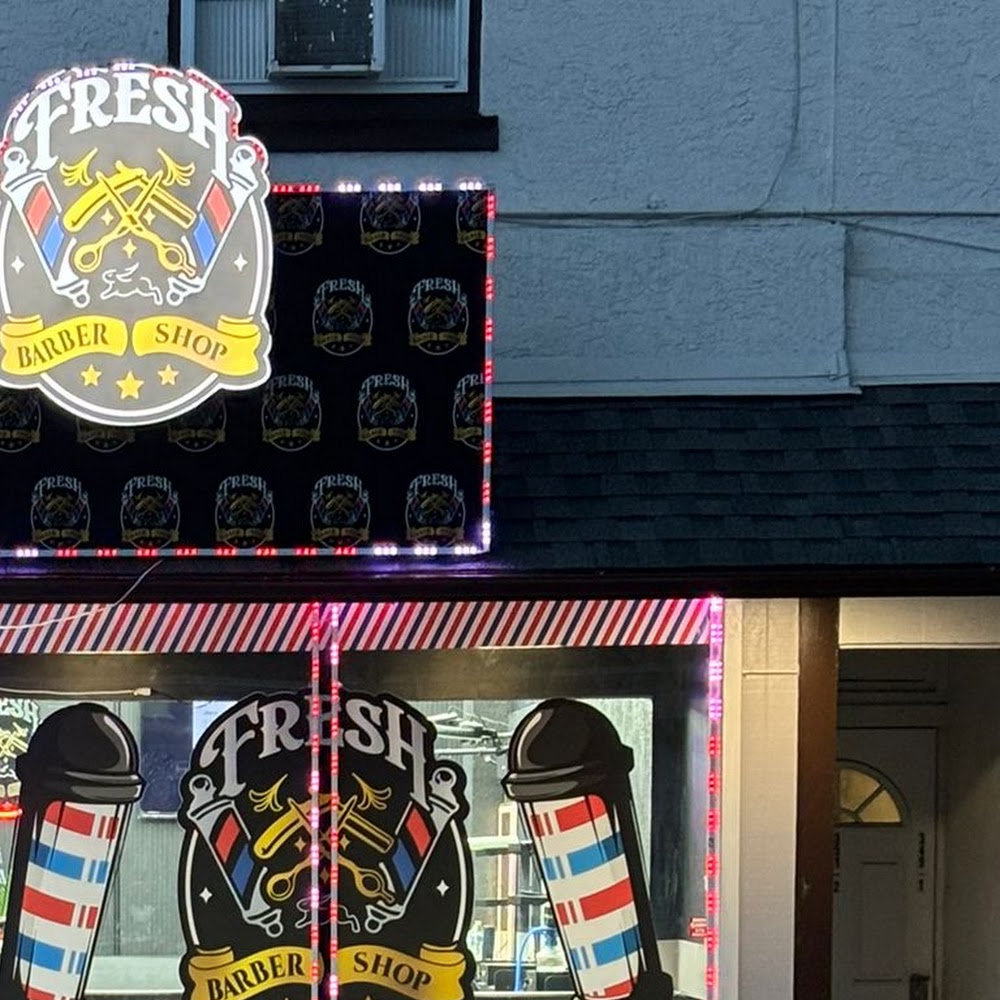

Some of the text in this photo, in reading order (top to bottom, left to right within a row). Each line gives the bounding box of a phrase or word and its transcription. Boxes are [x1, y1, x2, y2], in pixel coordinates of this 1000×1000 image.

[13, 71, 230, 189] FRESH
[18, 323, 110, 369] BARBER
[155, 323, 228, 361] SHOP
[200, 697, 430, 811] FRESH
[354, 953, 431, 991] SHOP
